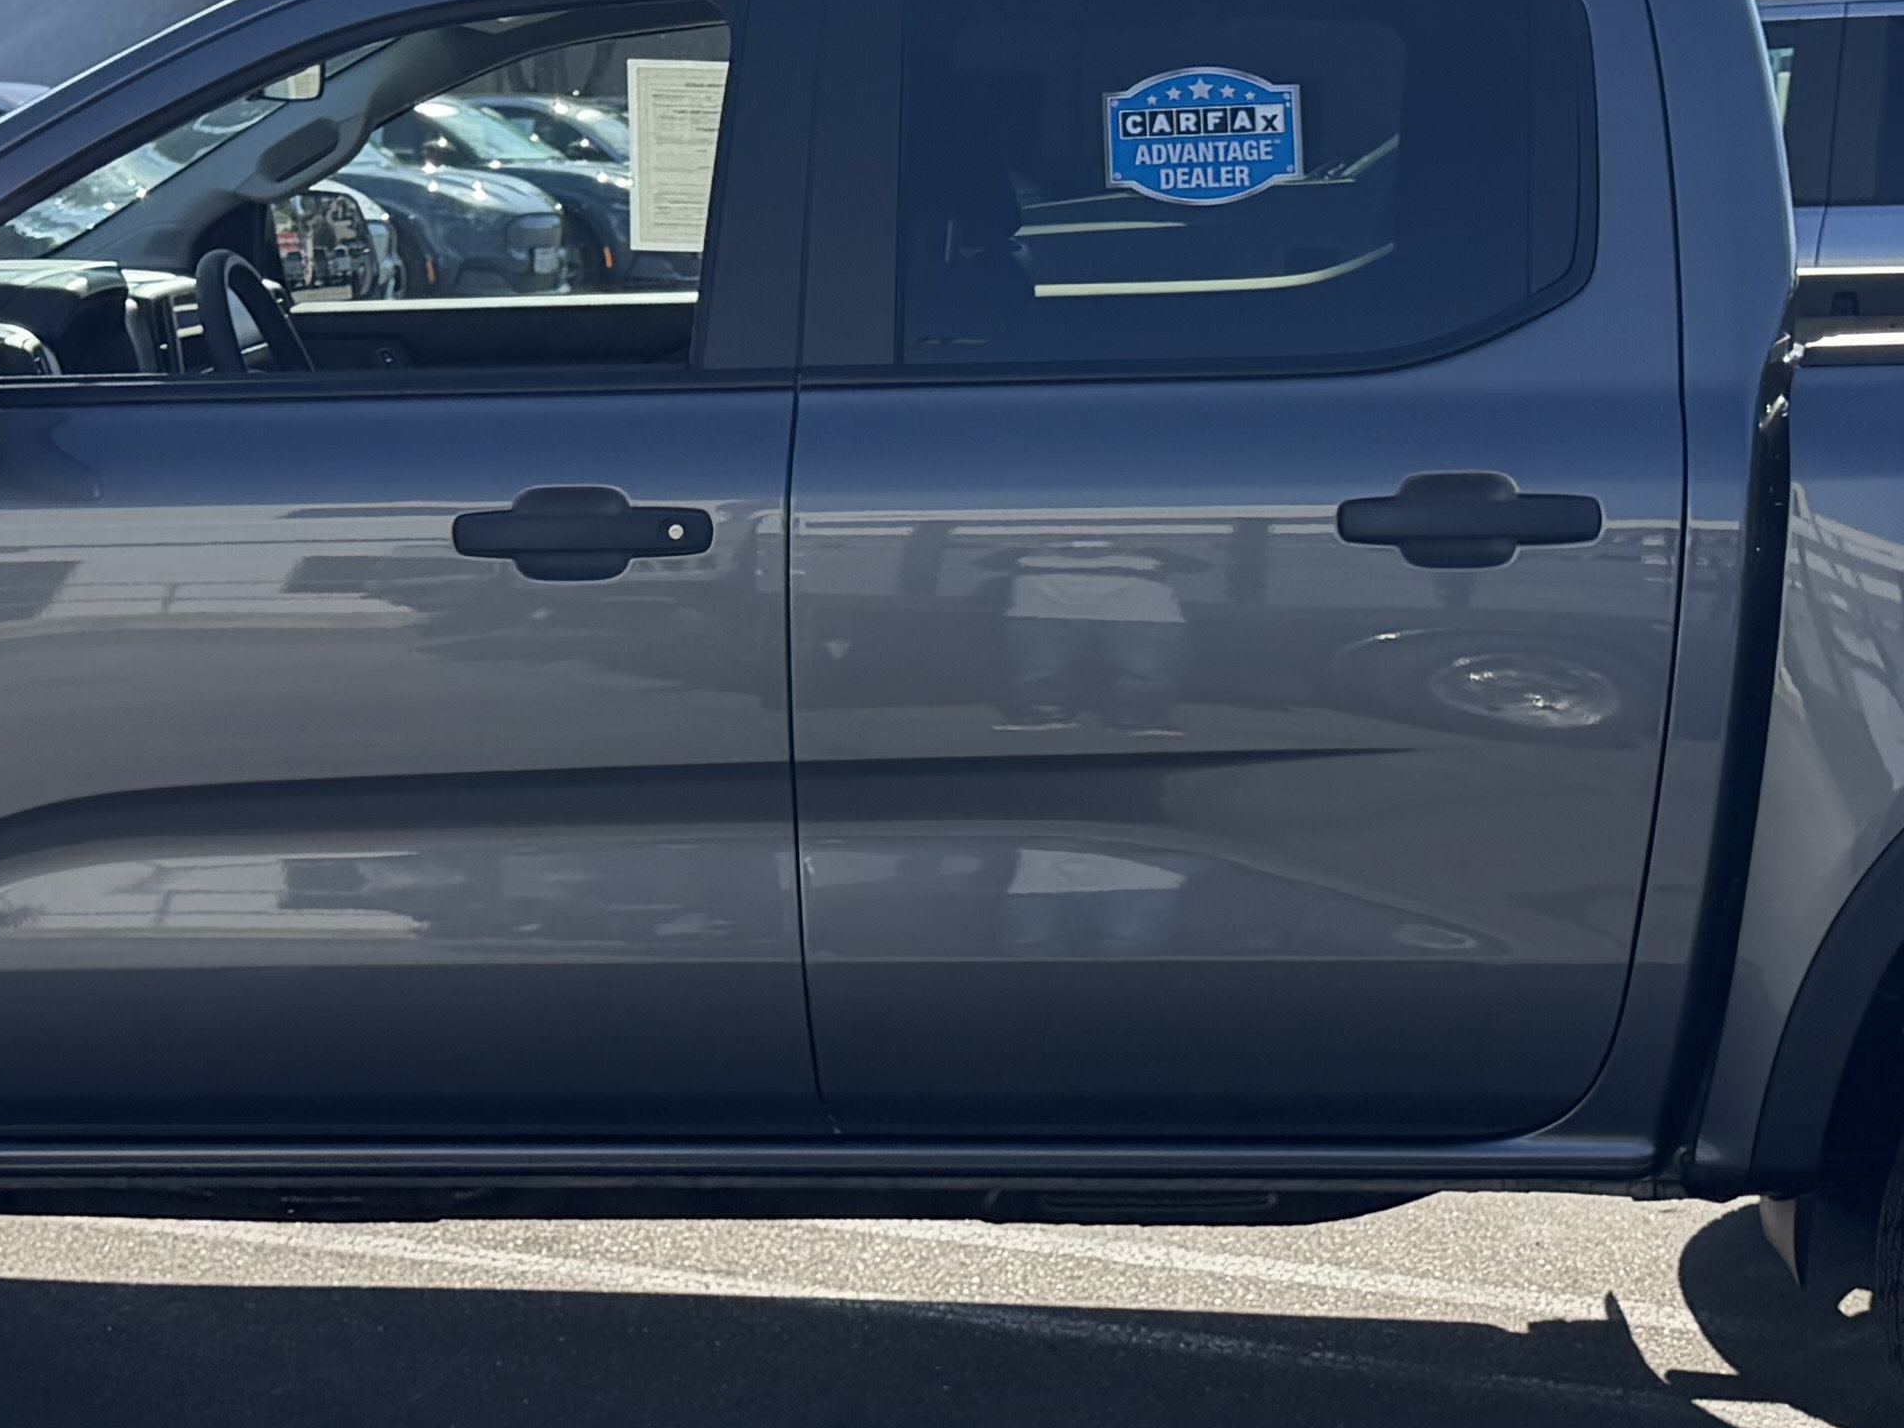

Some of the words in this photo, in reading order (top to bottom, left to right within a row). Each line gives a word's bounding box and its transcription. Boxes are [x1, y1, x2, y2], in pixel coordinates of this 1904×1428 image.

[1122, 108, 1281, 136] CARFAX
[1135, 140, 1275, 165] ADVANTAGE
[1159, 166, 1250, 190] DEALER
